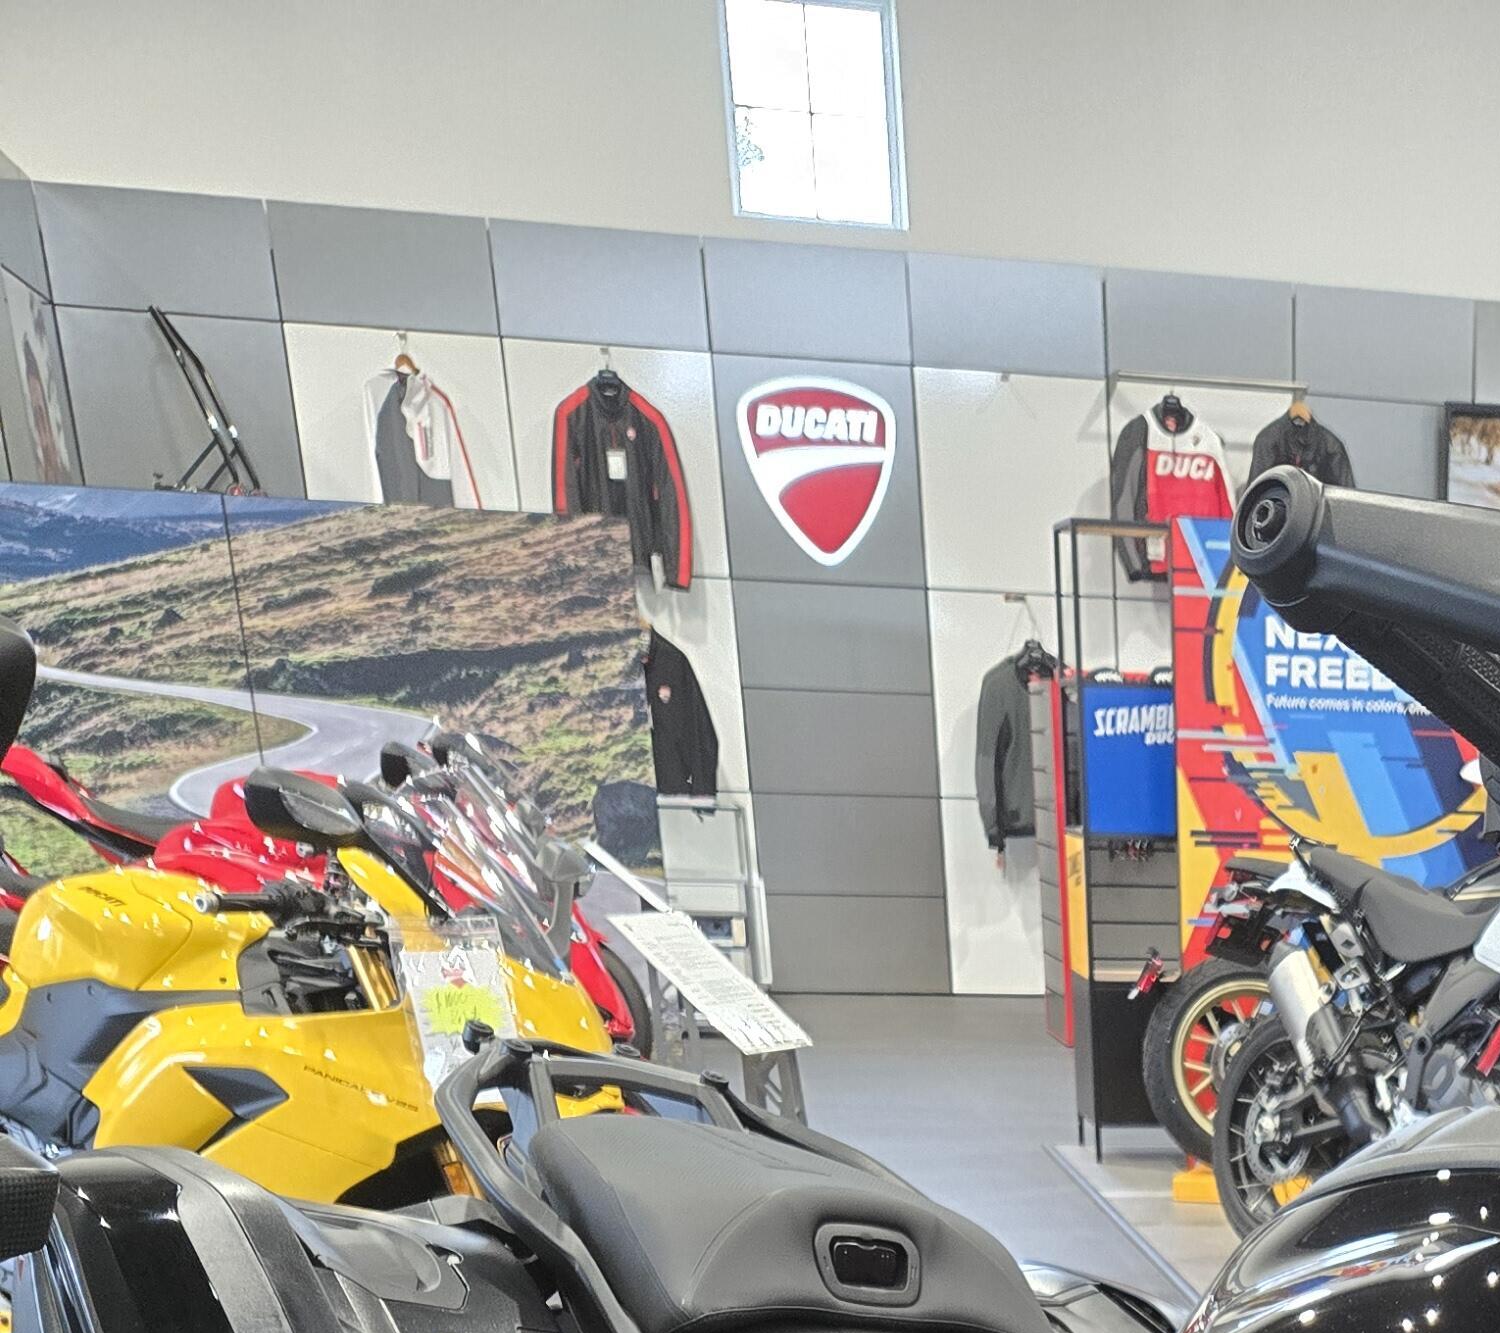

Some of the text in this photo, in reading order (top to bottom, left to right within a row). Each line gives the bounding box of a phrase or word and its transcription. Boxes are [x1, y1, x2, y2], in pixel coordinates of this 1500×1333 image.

[755, 403, 878, 443] DUCATI
[1266, 693, 1307, 710] Future
[303, 1065, 382, 1098] PANIGAL
